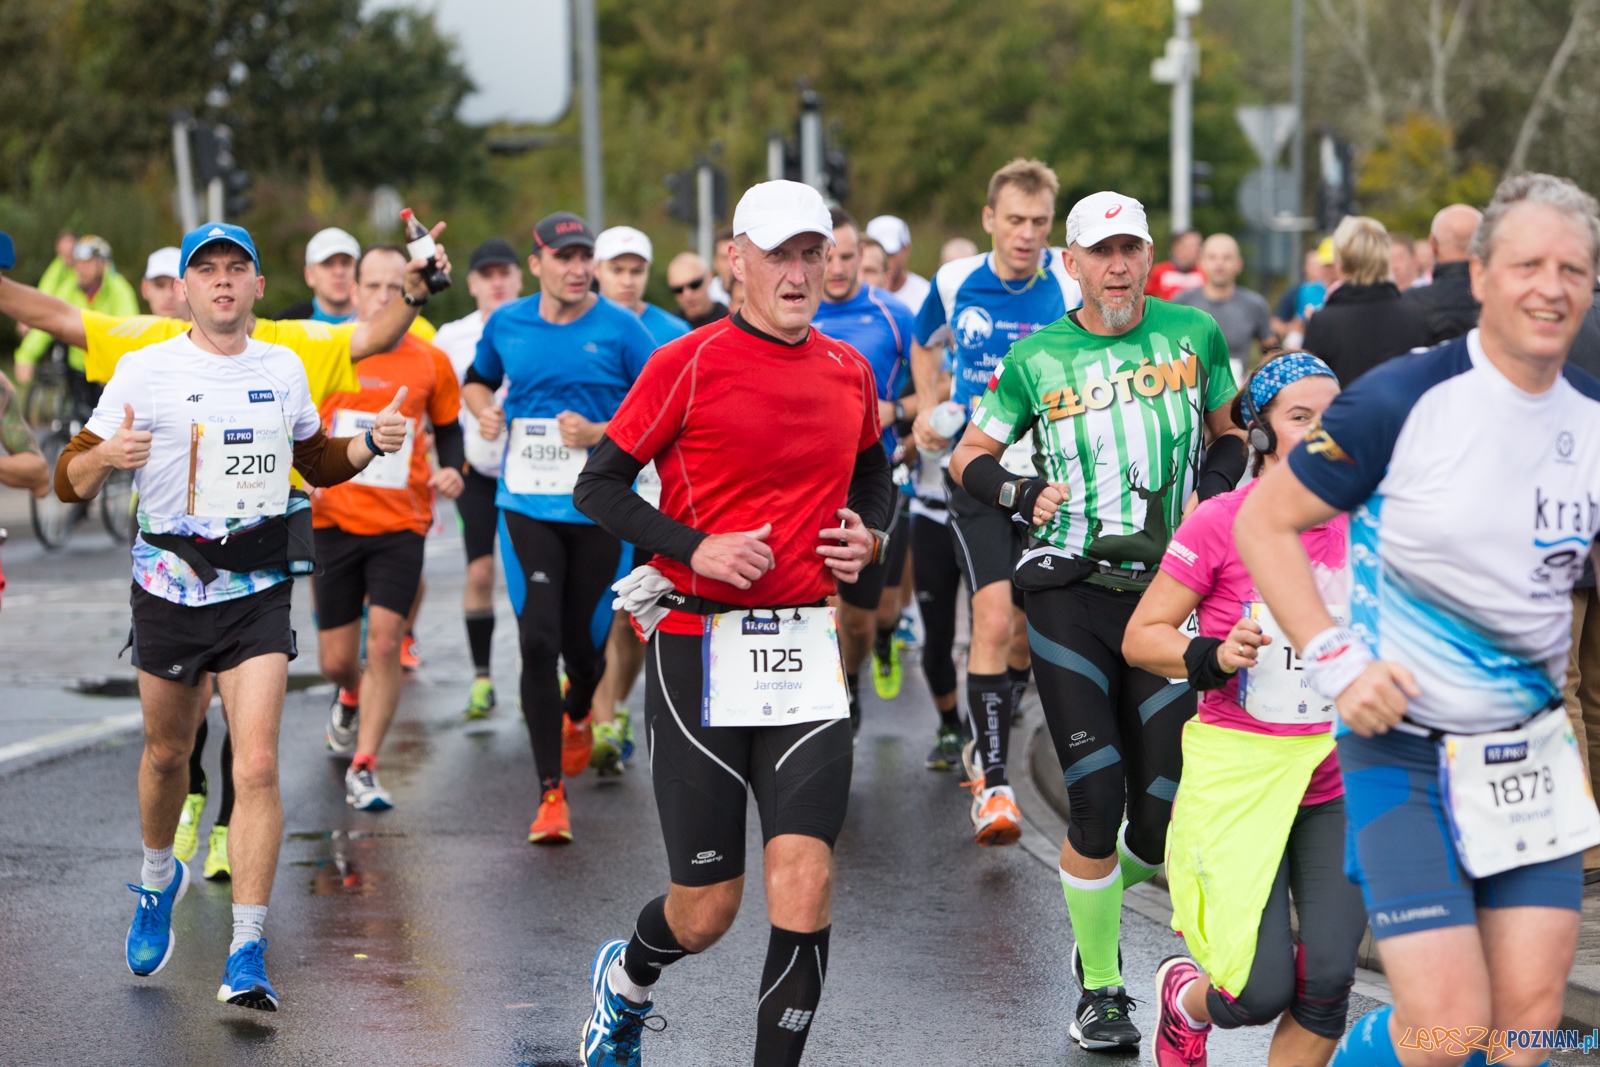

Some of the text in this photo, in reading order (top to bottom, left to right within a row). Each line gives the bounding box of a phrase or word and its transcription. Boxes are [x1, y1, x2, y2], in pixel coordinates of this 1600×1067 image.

[187, 393, 204, 403] 4F
[1042, 356, 1197, 421] ZŁOTÓW
[521, 444, 570, 461] 4396
[225, 453, 276, 475] 2210
[237, 480, 266, 489] Maciej
[749, 648, 803, 673] 1125
[753, 680, 803, 691] Jarosław
[1488, 766, 1555, 807] 1878
